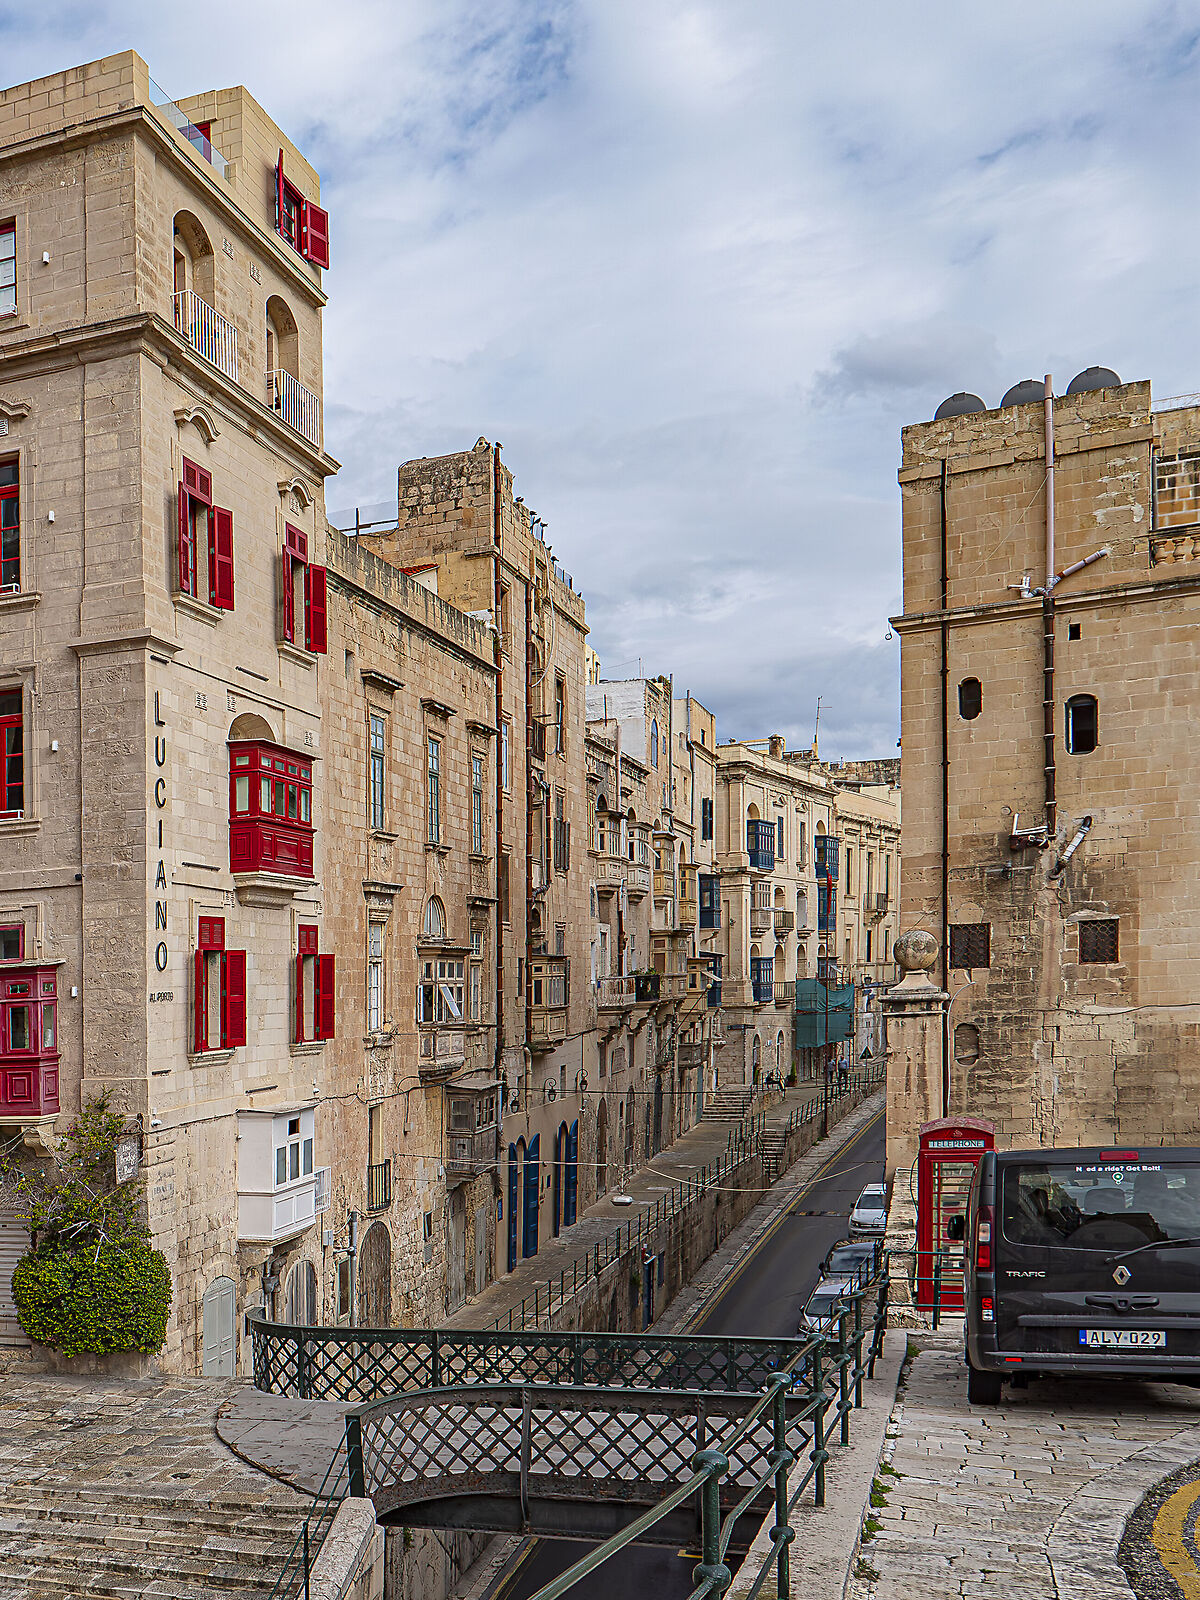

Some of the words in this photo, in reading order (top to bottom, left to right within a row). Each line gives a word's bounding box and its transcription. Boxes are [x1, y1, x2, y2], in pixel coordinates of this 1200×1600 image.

[154, 690, 168, 973] LUCIANO
[1005, 1270, 1046, 1278] TRAFIC
[1090, 1331, 1123, 1344] ALY
[1129, 1332, 1161, 1345] 029
